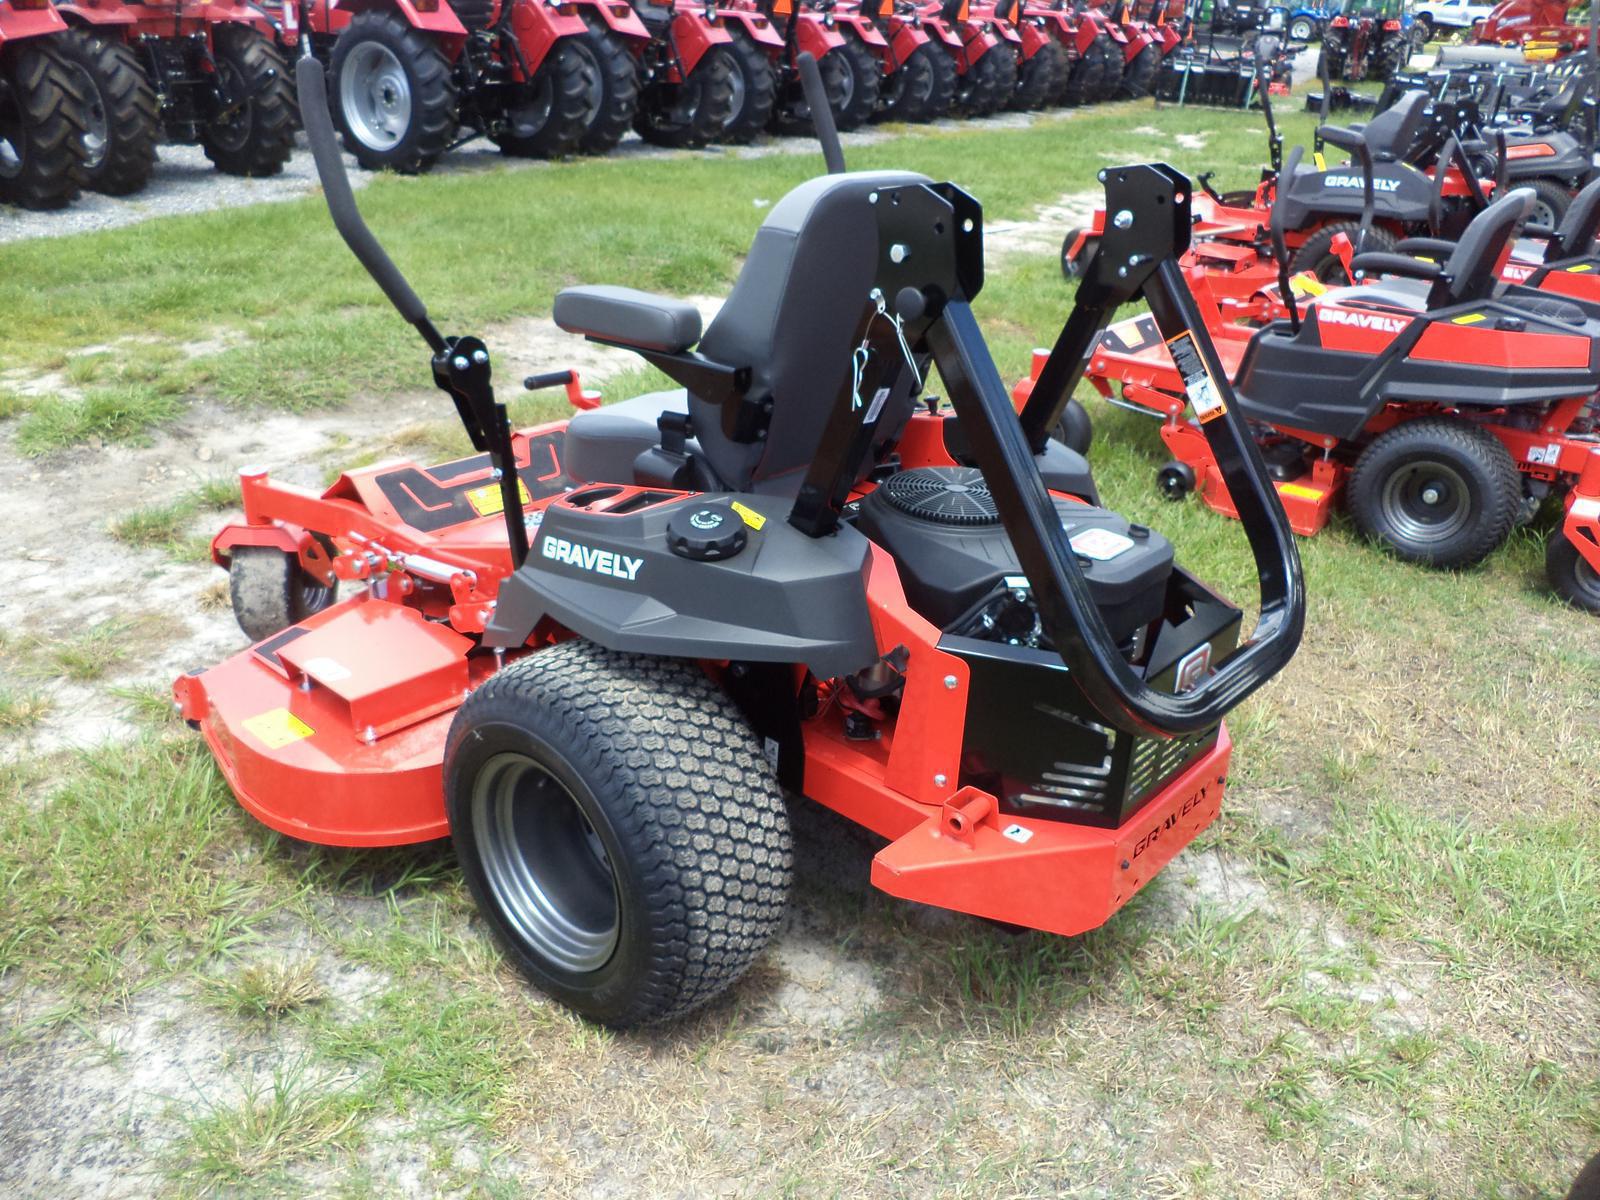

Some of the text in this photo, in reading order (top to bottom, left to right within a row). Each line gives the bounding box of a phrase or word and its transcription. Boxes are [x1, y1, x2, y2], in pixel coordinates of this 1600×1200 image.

[1319, 308, 1407, 334] GRAVELY
[542, 535, 644, 581] GRAVELY
[1133, 781, 1211, 859] GRAVELY
